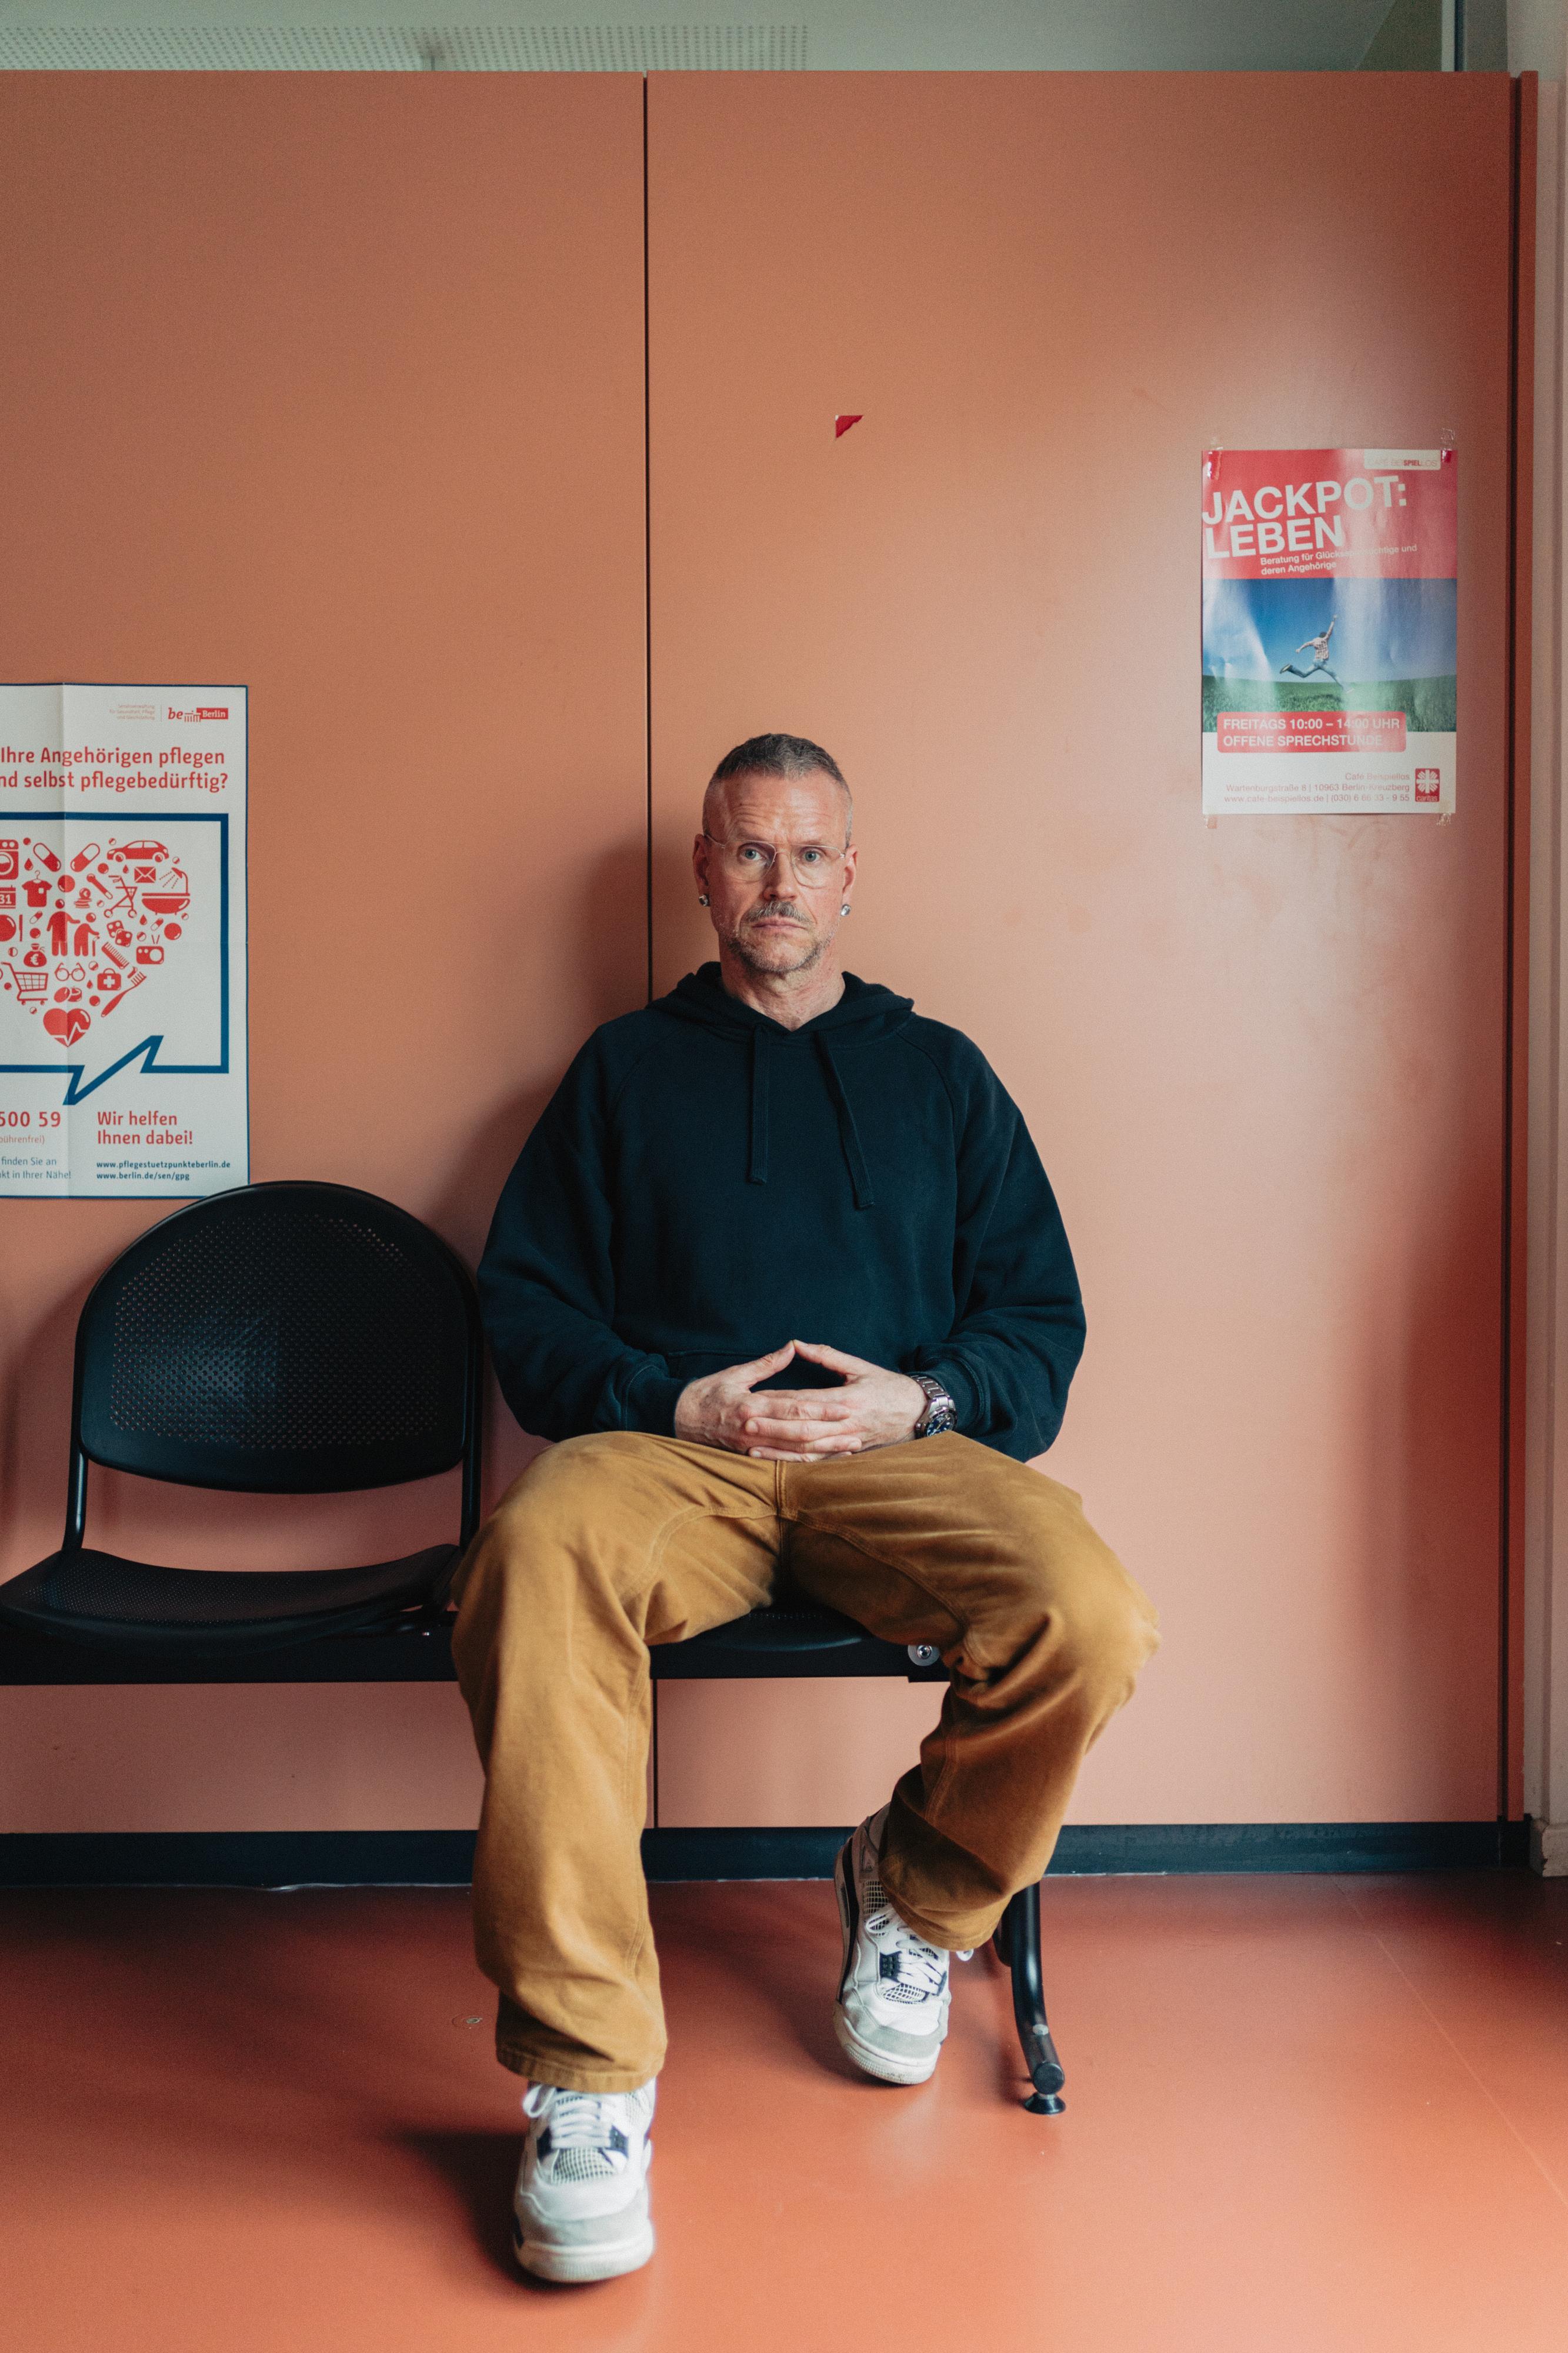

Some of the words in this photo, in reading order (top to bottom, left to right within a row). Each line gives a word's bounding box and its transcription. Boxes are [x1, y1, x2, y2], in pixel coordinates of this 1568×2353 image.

[1202, 475, 1407, 525] JACKPOT:
[1205, 515, 1345, 559] LEBEN
[1260, 555, 1299, 566] Beratung
[1301, 553, 1313, 561] für
[1401, 544, 1417, 552] und
[1261, 566, 1286, 575] deren
[1288, 561, 1337, 574] Angehörige
[202, 709, 226, 718] Berlin
[1223, 719, 1286, 730] FREITAGS
[1290, 718, 1323, 729] 10:00
[1337, 718, 1369, 729] 1400
[1373, 718, 1400, 729] UHR
[1223, 735, 1274, 746] OFFENE
[1277, 735, 1383, 746] SPRECHSTUNDE
[1, 746, 35, 763] Ihre
[41, 746, 152, 767] Angehörigen
[159, 746, 225, 768] pflegen
[24, 771, 75, 788] selbst
[81, 771, 228, 793] pflegebedürftig?
[39, 1111, 61, 1128] 59
[97, 1111, 124, 1125] Wir
[129, 1111, 178, 1125] helfen
[97, 1130, 141, 1144] Ihnen
[146, 1129, 194, 1144] dabei!
[1, 1156, 28, 1165] finden
[31, 1156, 43, 1165] Sie
[0, 1170, 9, 1179] kt
[12, 1170, 20, 1178] in
[23, 1170, 43, 1179] Ihrer
[46, 1170, 71, 1179] Nähe!
[96, 1172, 190, 1182] www.berlin.de/sen/gpg
